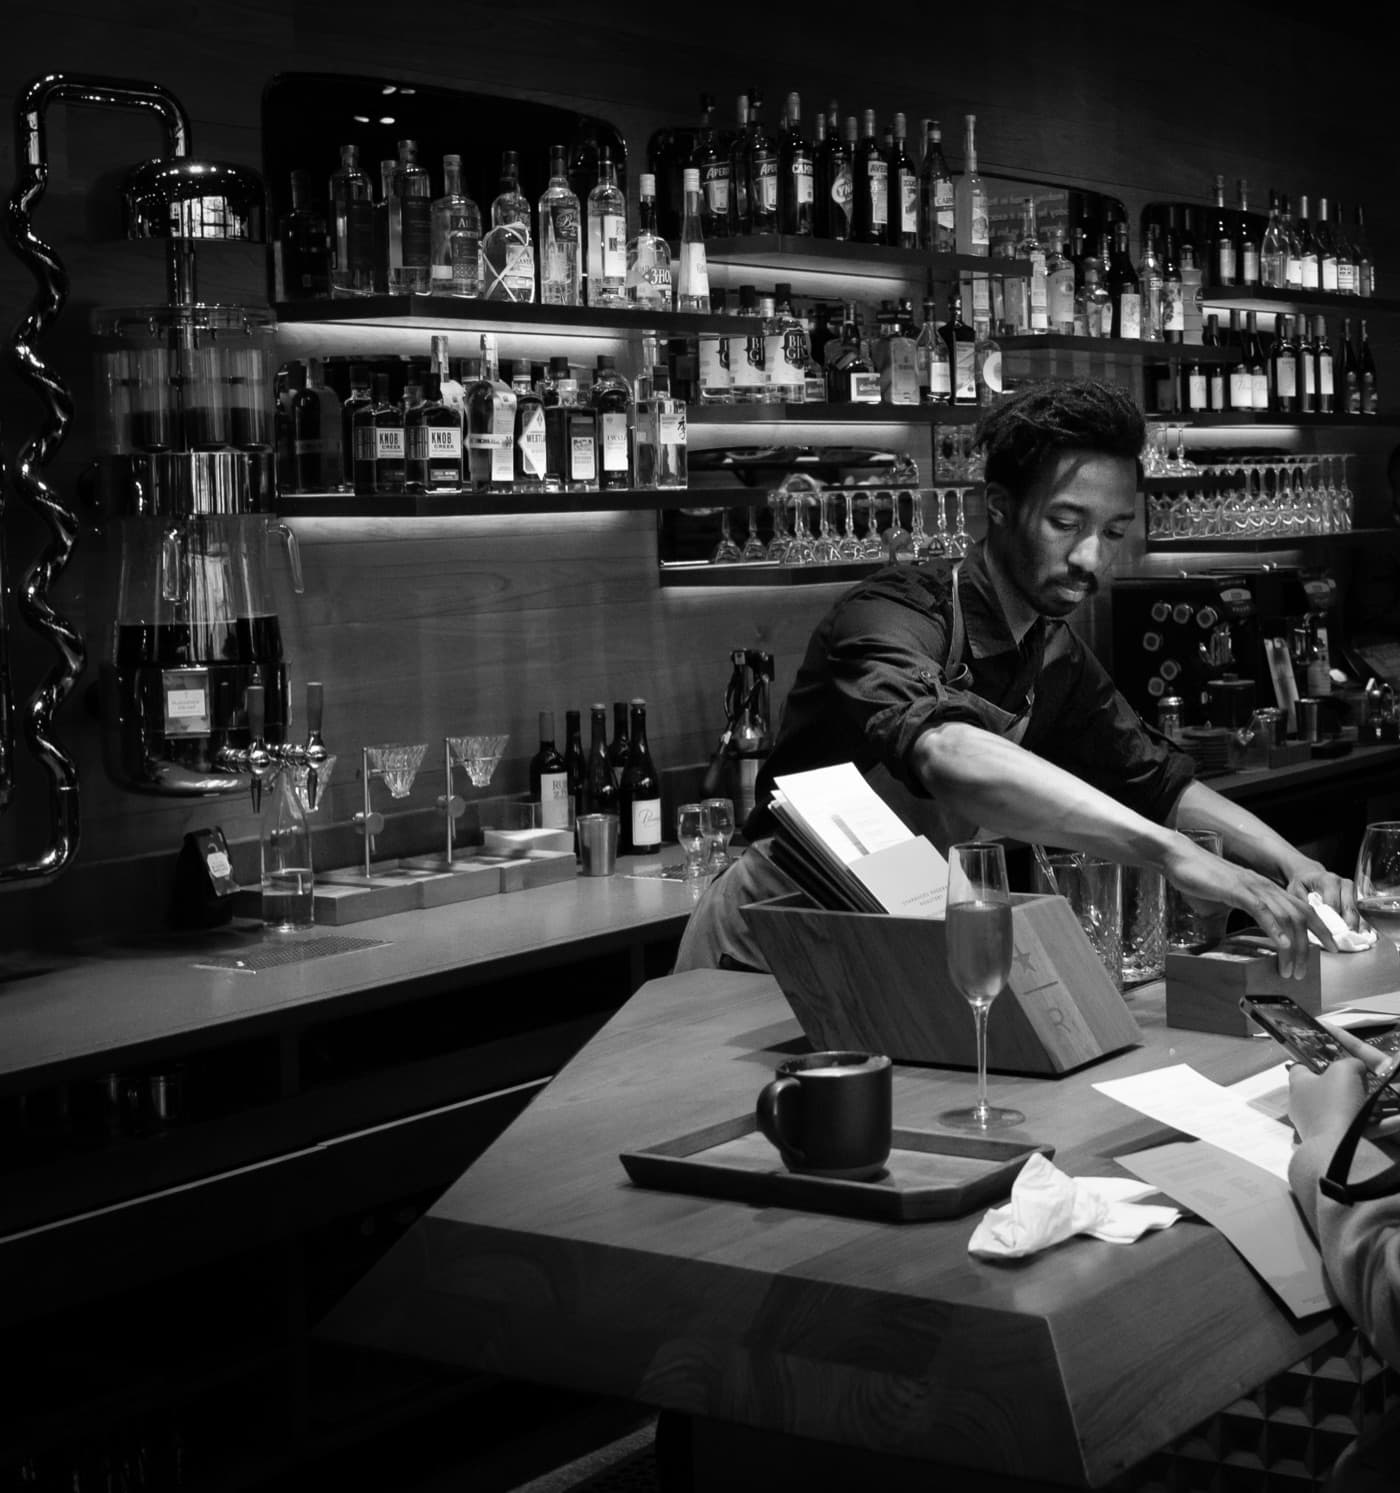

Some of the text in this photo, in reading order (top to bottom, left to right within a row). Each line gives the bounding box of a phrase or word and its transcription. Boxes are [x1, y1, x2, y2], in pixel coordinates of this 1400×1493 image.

[752, 337, 763, 348] BI
[749, 348, 763, 361] GI
[380, 432, 398, 444] KNOB
[431, 432, 452, 444] KNOB
